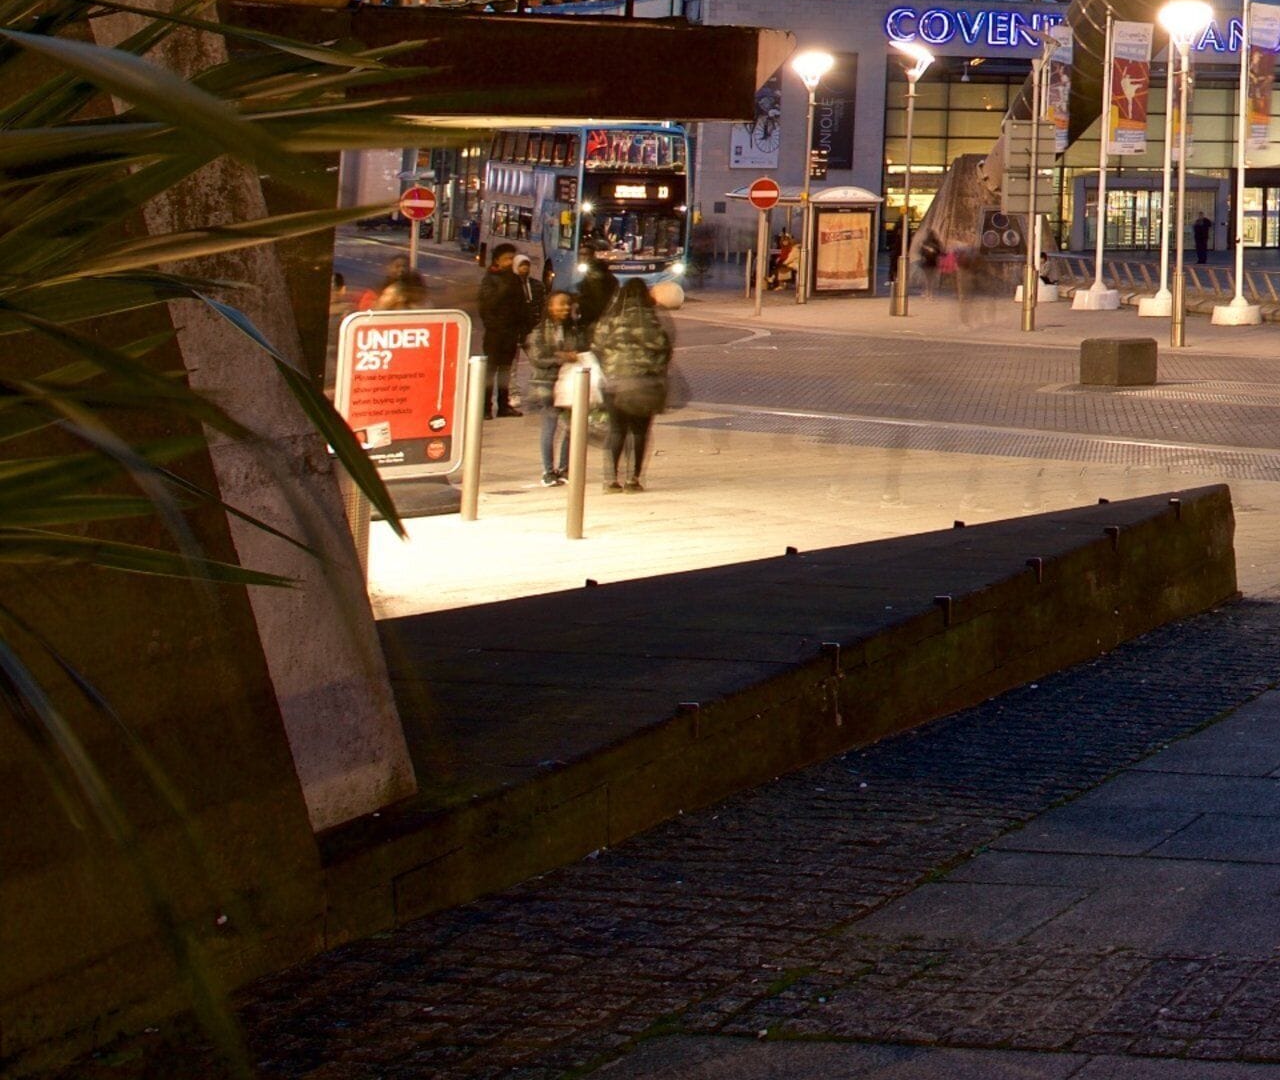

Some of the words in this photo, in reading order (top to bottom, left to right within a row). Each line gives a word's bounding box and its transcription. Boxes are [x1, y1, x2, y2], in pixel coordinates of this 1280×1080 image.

[885, 7, 1064, 47] COVEN
[820, 97, 834, 152] UNIQUE
[356, 328, 430, 350] UNDER
[355, 350, 393, 370] 25?
